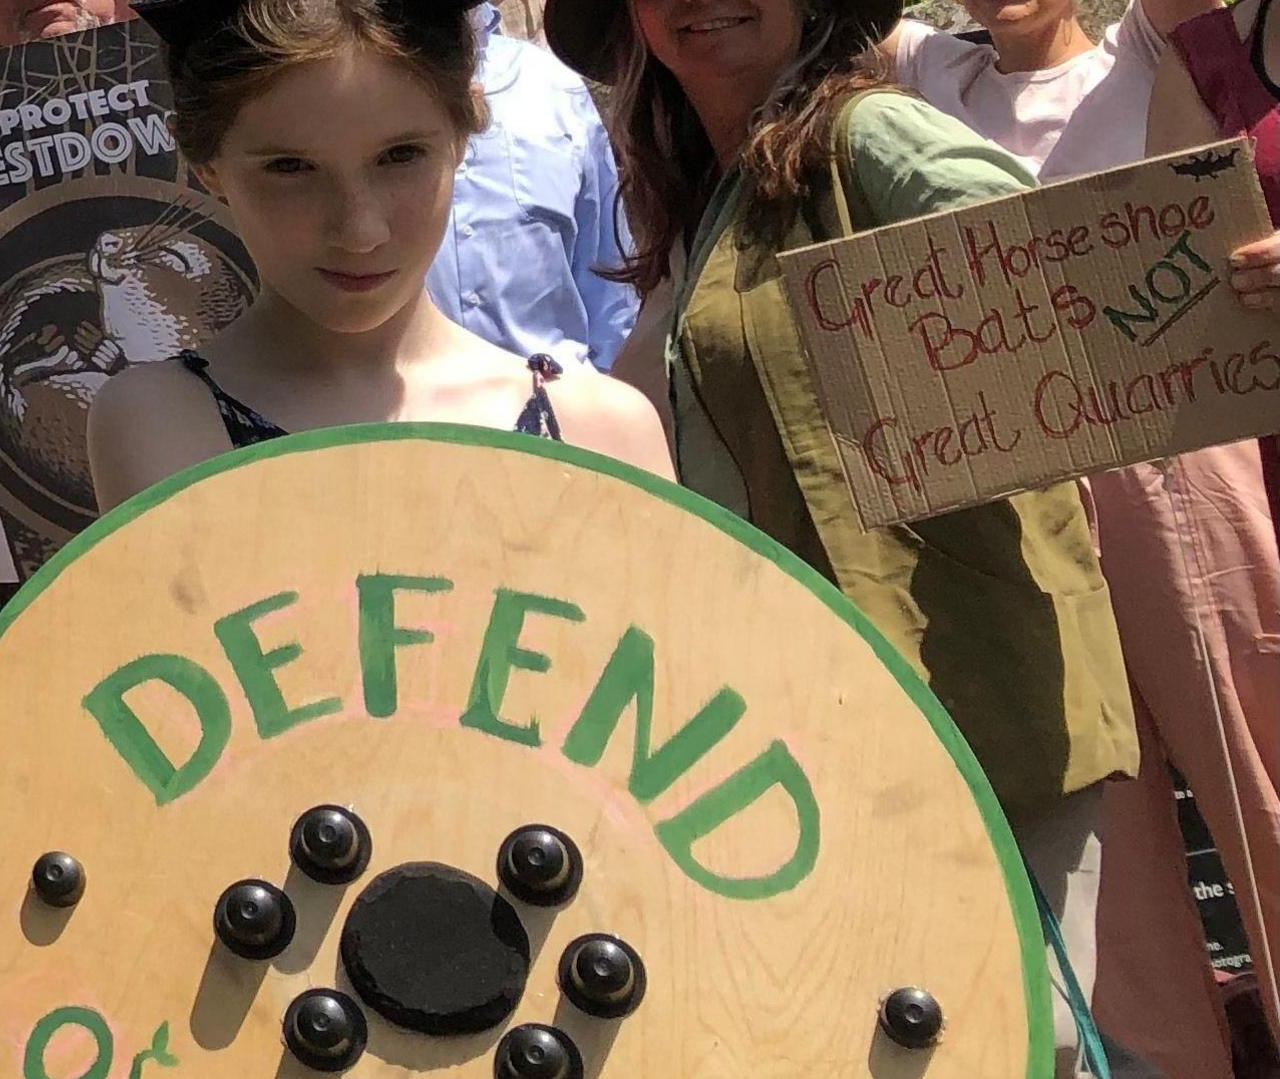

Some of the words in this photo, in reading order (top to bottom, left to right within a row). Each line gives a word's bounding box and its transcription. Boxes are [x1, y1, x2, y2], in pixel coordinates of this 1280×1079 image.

[804, 238, 965, 341] Great
[908, 283, 1098, 371] Bats
[1102, 229, 1214, 343] NOT
[862, 391, 1020, 493] Great
[1034, 339, 1280, 441] Quarries
[81, 570, 822, 903] DEFEND
[1192, 880, 1224, 902] the
